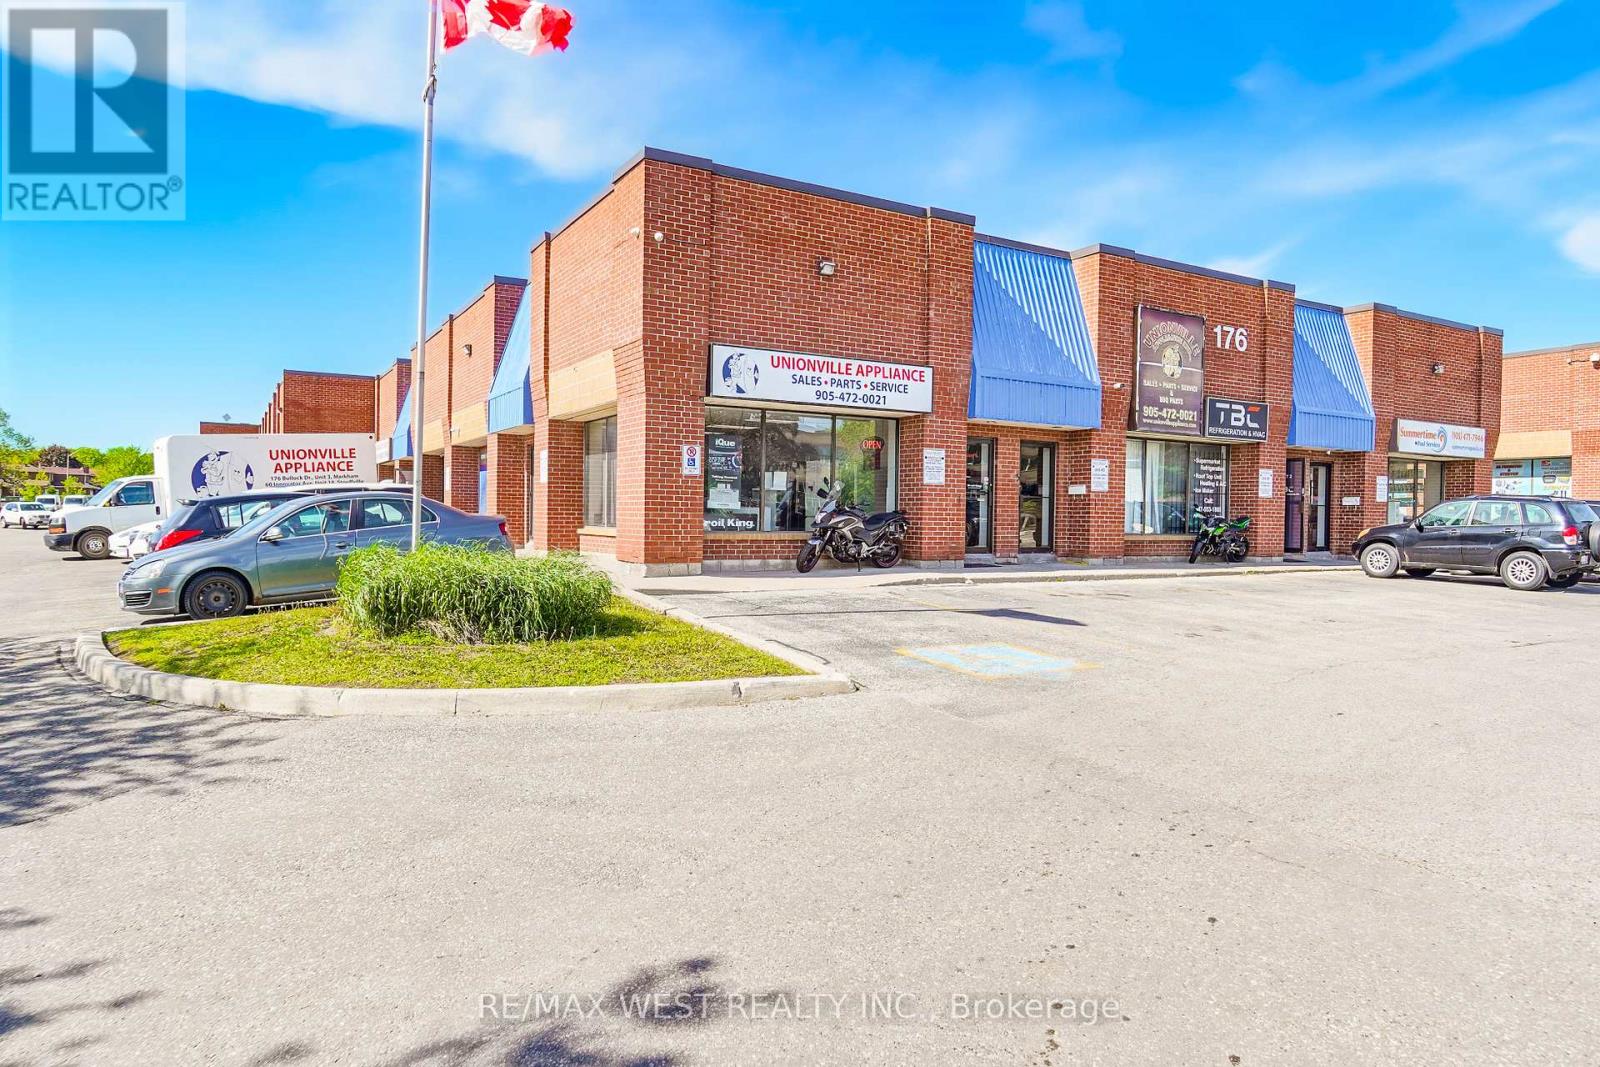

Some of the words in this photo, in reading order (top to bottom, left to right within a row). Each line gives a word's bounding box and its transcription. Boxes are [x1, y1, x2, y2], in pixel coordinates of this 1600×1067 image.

[1213, 325, 1248, 352] 176
[770, 355, 852, 375] UNIONVILLE
[856, 364, 925, 382] APPLIANCE
[791, 374, 822, 386] SALES
[830, 378, 862, 390] PARTS
[870, 381, 909, 393] SERVICE
[815, 390, 887, 405] 905-472-0021
[1142, 406, 1197, 421] 905-472-0021
[1215, 402, 1261, 428] TBC
[1208, 427, 1247, 437] REFRIGERATION
[1400, 426, 1437, 440] Summertime
[862, 440, 881, 449] OPEN
[269, 448, 356, 460] UNIONVILLE
[274, 461, 354, 473] APPLIANCE
[1196, 457, 1221, 466] Supermarket
[704, 518, 725, 528] roil
